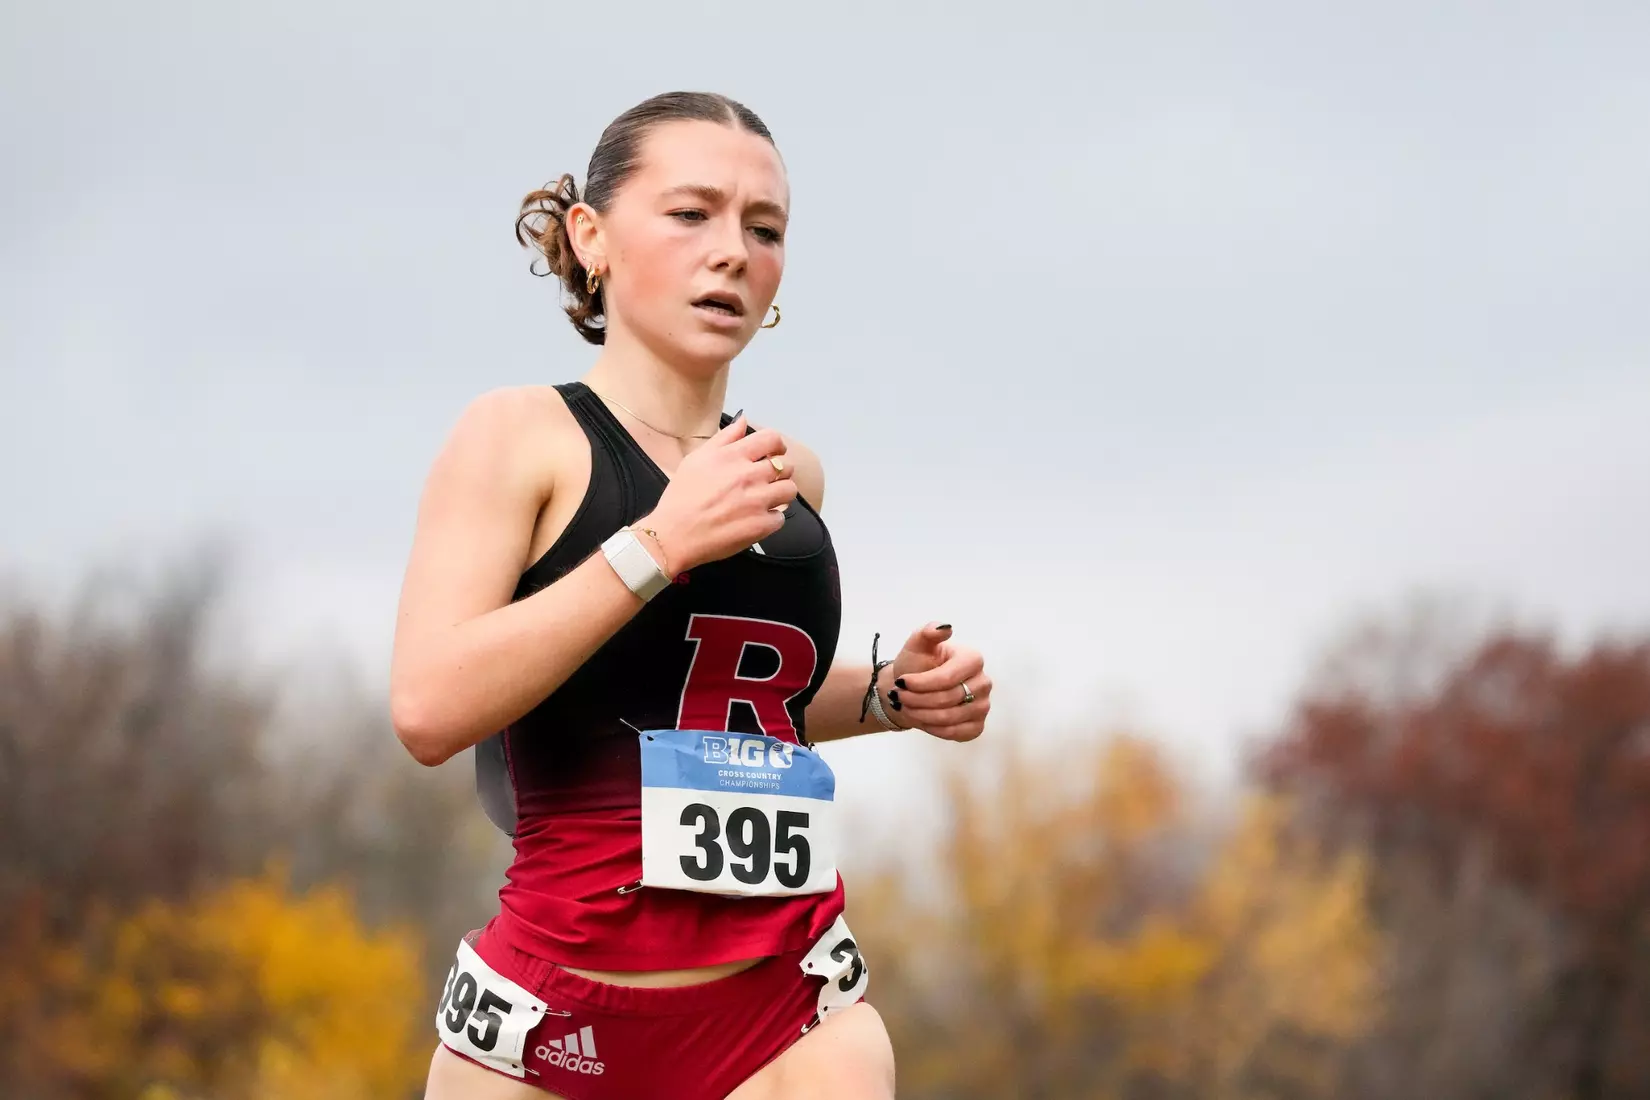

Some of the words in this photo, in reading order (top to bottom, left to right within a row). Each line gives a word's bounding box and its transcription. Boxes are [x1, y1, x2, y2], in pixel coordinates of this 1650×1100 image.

[676, 613, 817, 747] R
[718, 770, 744, 778] CROSS
[746, 772, 782, 781] COUNTRY
[719, 780, 780, 790] CHAMPIONSHIPS
[679, 803, 811, 889] 395
[534, 1045, 605, 1076] adidas
